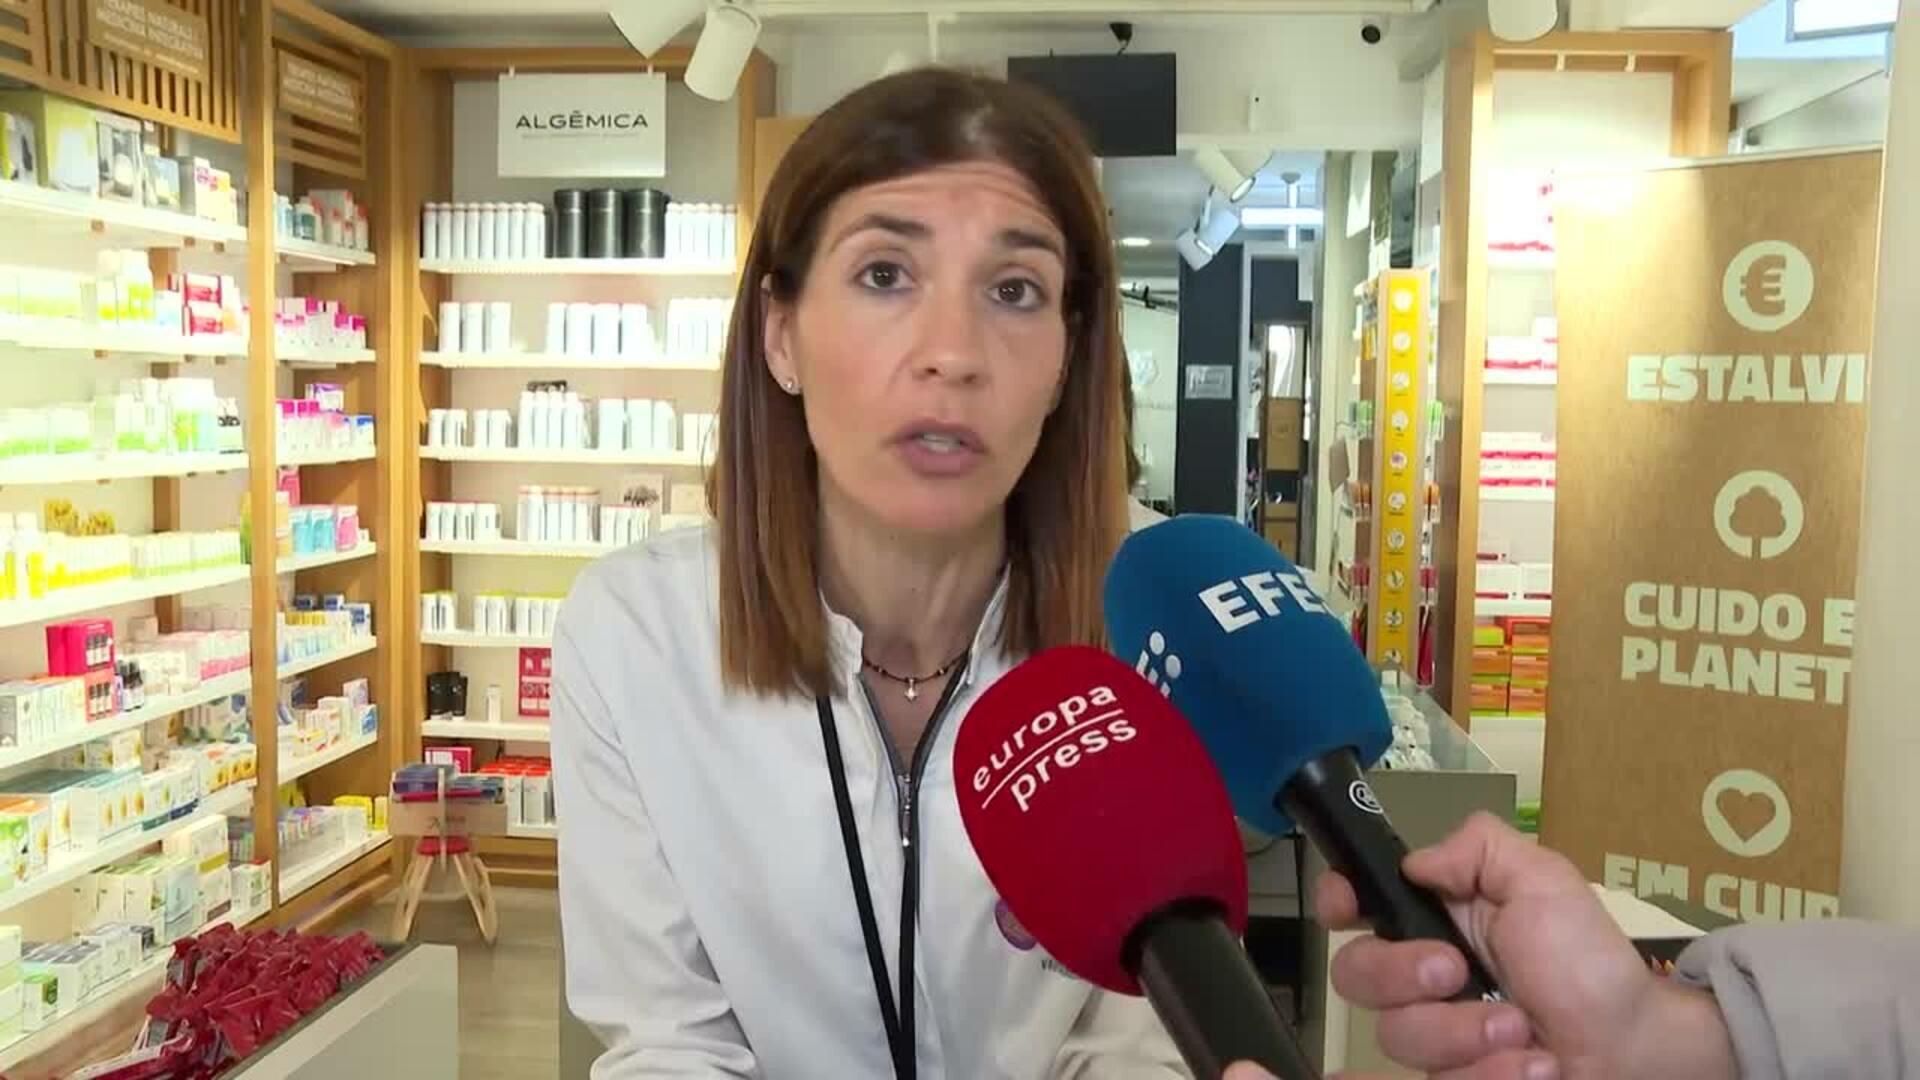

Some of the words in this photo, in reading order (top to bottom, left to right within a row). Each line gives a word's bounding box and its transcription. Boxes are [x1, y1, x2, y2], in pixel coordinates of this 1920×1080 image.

[1627, 353, 1866, 404] ESTALVI
[1198, 571, 1326, 634] EFE
[1623, 580, 1807, 642] CUIDO
[1822, 597, 1855, 648] E
[1620, 635, 1852, 706] PLANET
[972, 685, 1118, 792] europa
[1010, 719, 1137, 812] press
[1603, 852, 1690, 901] EM
